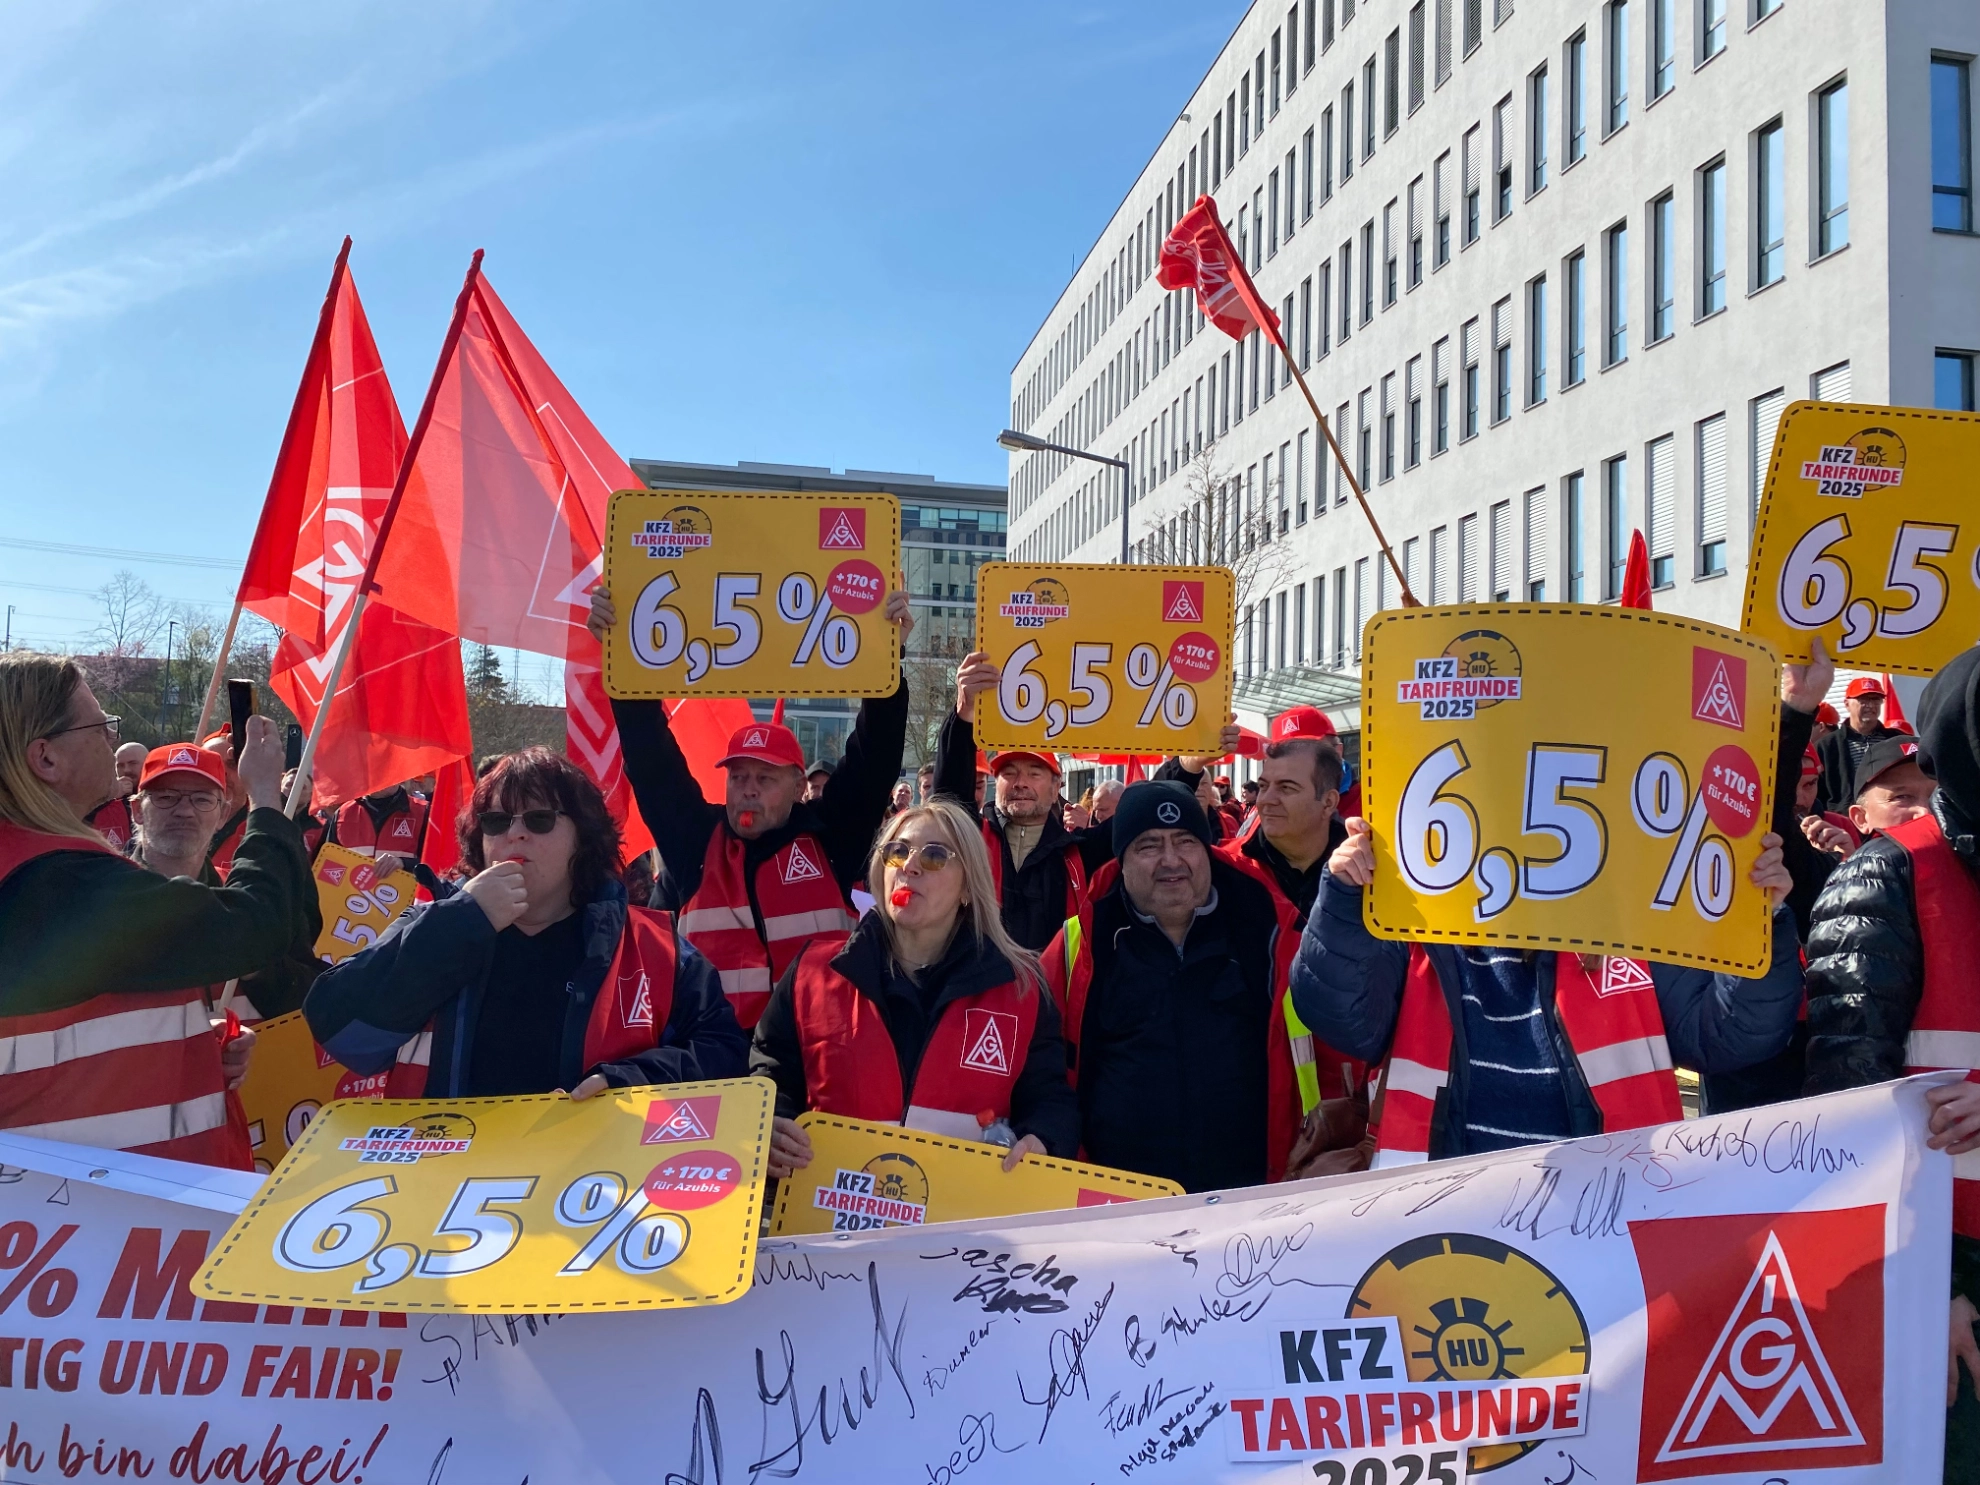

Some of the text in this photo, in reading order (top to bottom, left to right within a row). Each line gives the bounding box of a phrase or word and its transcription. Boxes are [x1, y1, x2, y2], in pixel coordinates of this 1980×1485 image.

[1822, 447, 1853, 463] KFZ
[1804, 463, 1900, 484] TARIFRUNDE
[1820, 480, 1863, 497] 2025
[646, 522, 670, 533] KFZ
[633, 534, 710, 546] TARIFRUNDE
[649, 546, 682, 557] 2025
[832, 585, 874, 601] für Azubis
[1011, 593, 1033, 604] KFZ
[1001, 605, 1067, 616] TARIFRUNDE
[1015, 616, 1044, 627] 2025
[1173, 655, 1210, 671] für Azubis
[1418, 660, 1454, 679] KFZ
[1472, 664, 1486, 674] HU
[1400, 679, 1518, 700] TARIFRUNDE
[1423, 699, 1473, 718] 2025
[1707, 783, 1751, 819] für Azubis
[369, 1128, 410, 1139] KFZ
[344, 1139, 468, 1151] TARIFRUNDE
[361, 1151, 419, 1163] 2025
[652, 1181, 721, 1193] für Azubis
[836, 1171, 872, 1194] KFZ
[818, 1188, 923, 1224] TARIFRUNDE
[1279, 1326, 1394, 1384] KFZ
[1446, 1338, 1488, 1367] HU
[99, 1340, 228, 1396] UND
[241, 1344, 403, 1402] FAIR!
[1230, 1383, 1581, 1452] TARIFRUNDE
[58, 1423, 154, 1478] bin
[168, 1421, 389, 1485] dabei!
